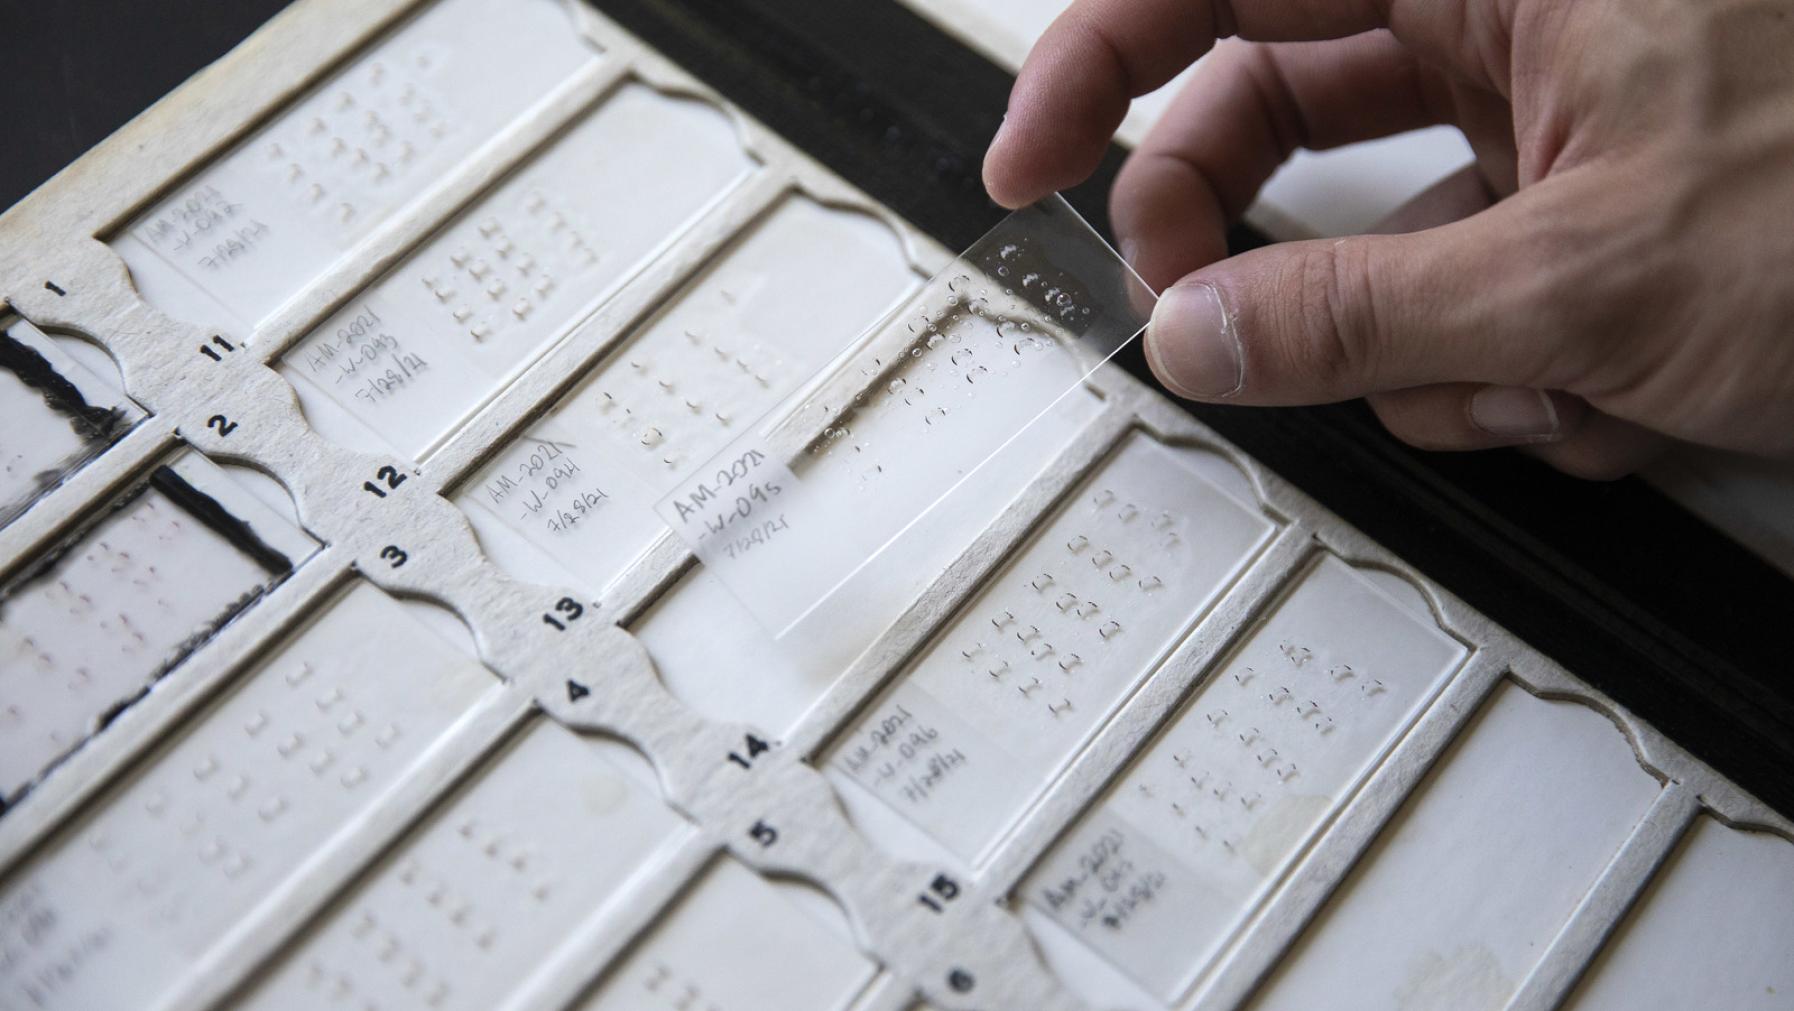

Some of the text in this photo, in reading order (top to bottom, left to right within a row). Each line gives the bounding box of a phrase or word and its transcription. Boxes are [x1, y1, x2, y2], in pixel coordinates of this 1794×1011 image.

[45, 281, 66, 296] 1
[200, 334, 235, 361] 11
[304, 304, 381, 372] AM-2021
[207, 414, 238, 437] 2
[363, 465, 407, 498] 12
[486, 442, 562, 504] AM-2021
[673, 449, 765, 523] AM-2021
[547, 488, 609, 531] 7/28/21
[380, 545, 408, 568] 3
[542, 597, 583, 631] 13
[567, 679, 590, 703] 4
[727, 732, 770, 769] 14
[748, 819, 778, 846] 5
[917, 874, 960, 914] 15
